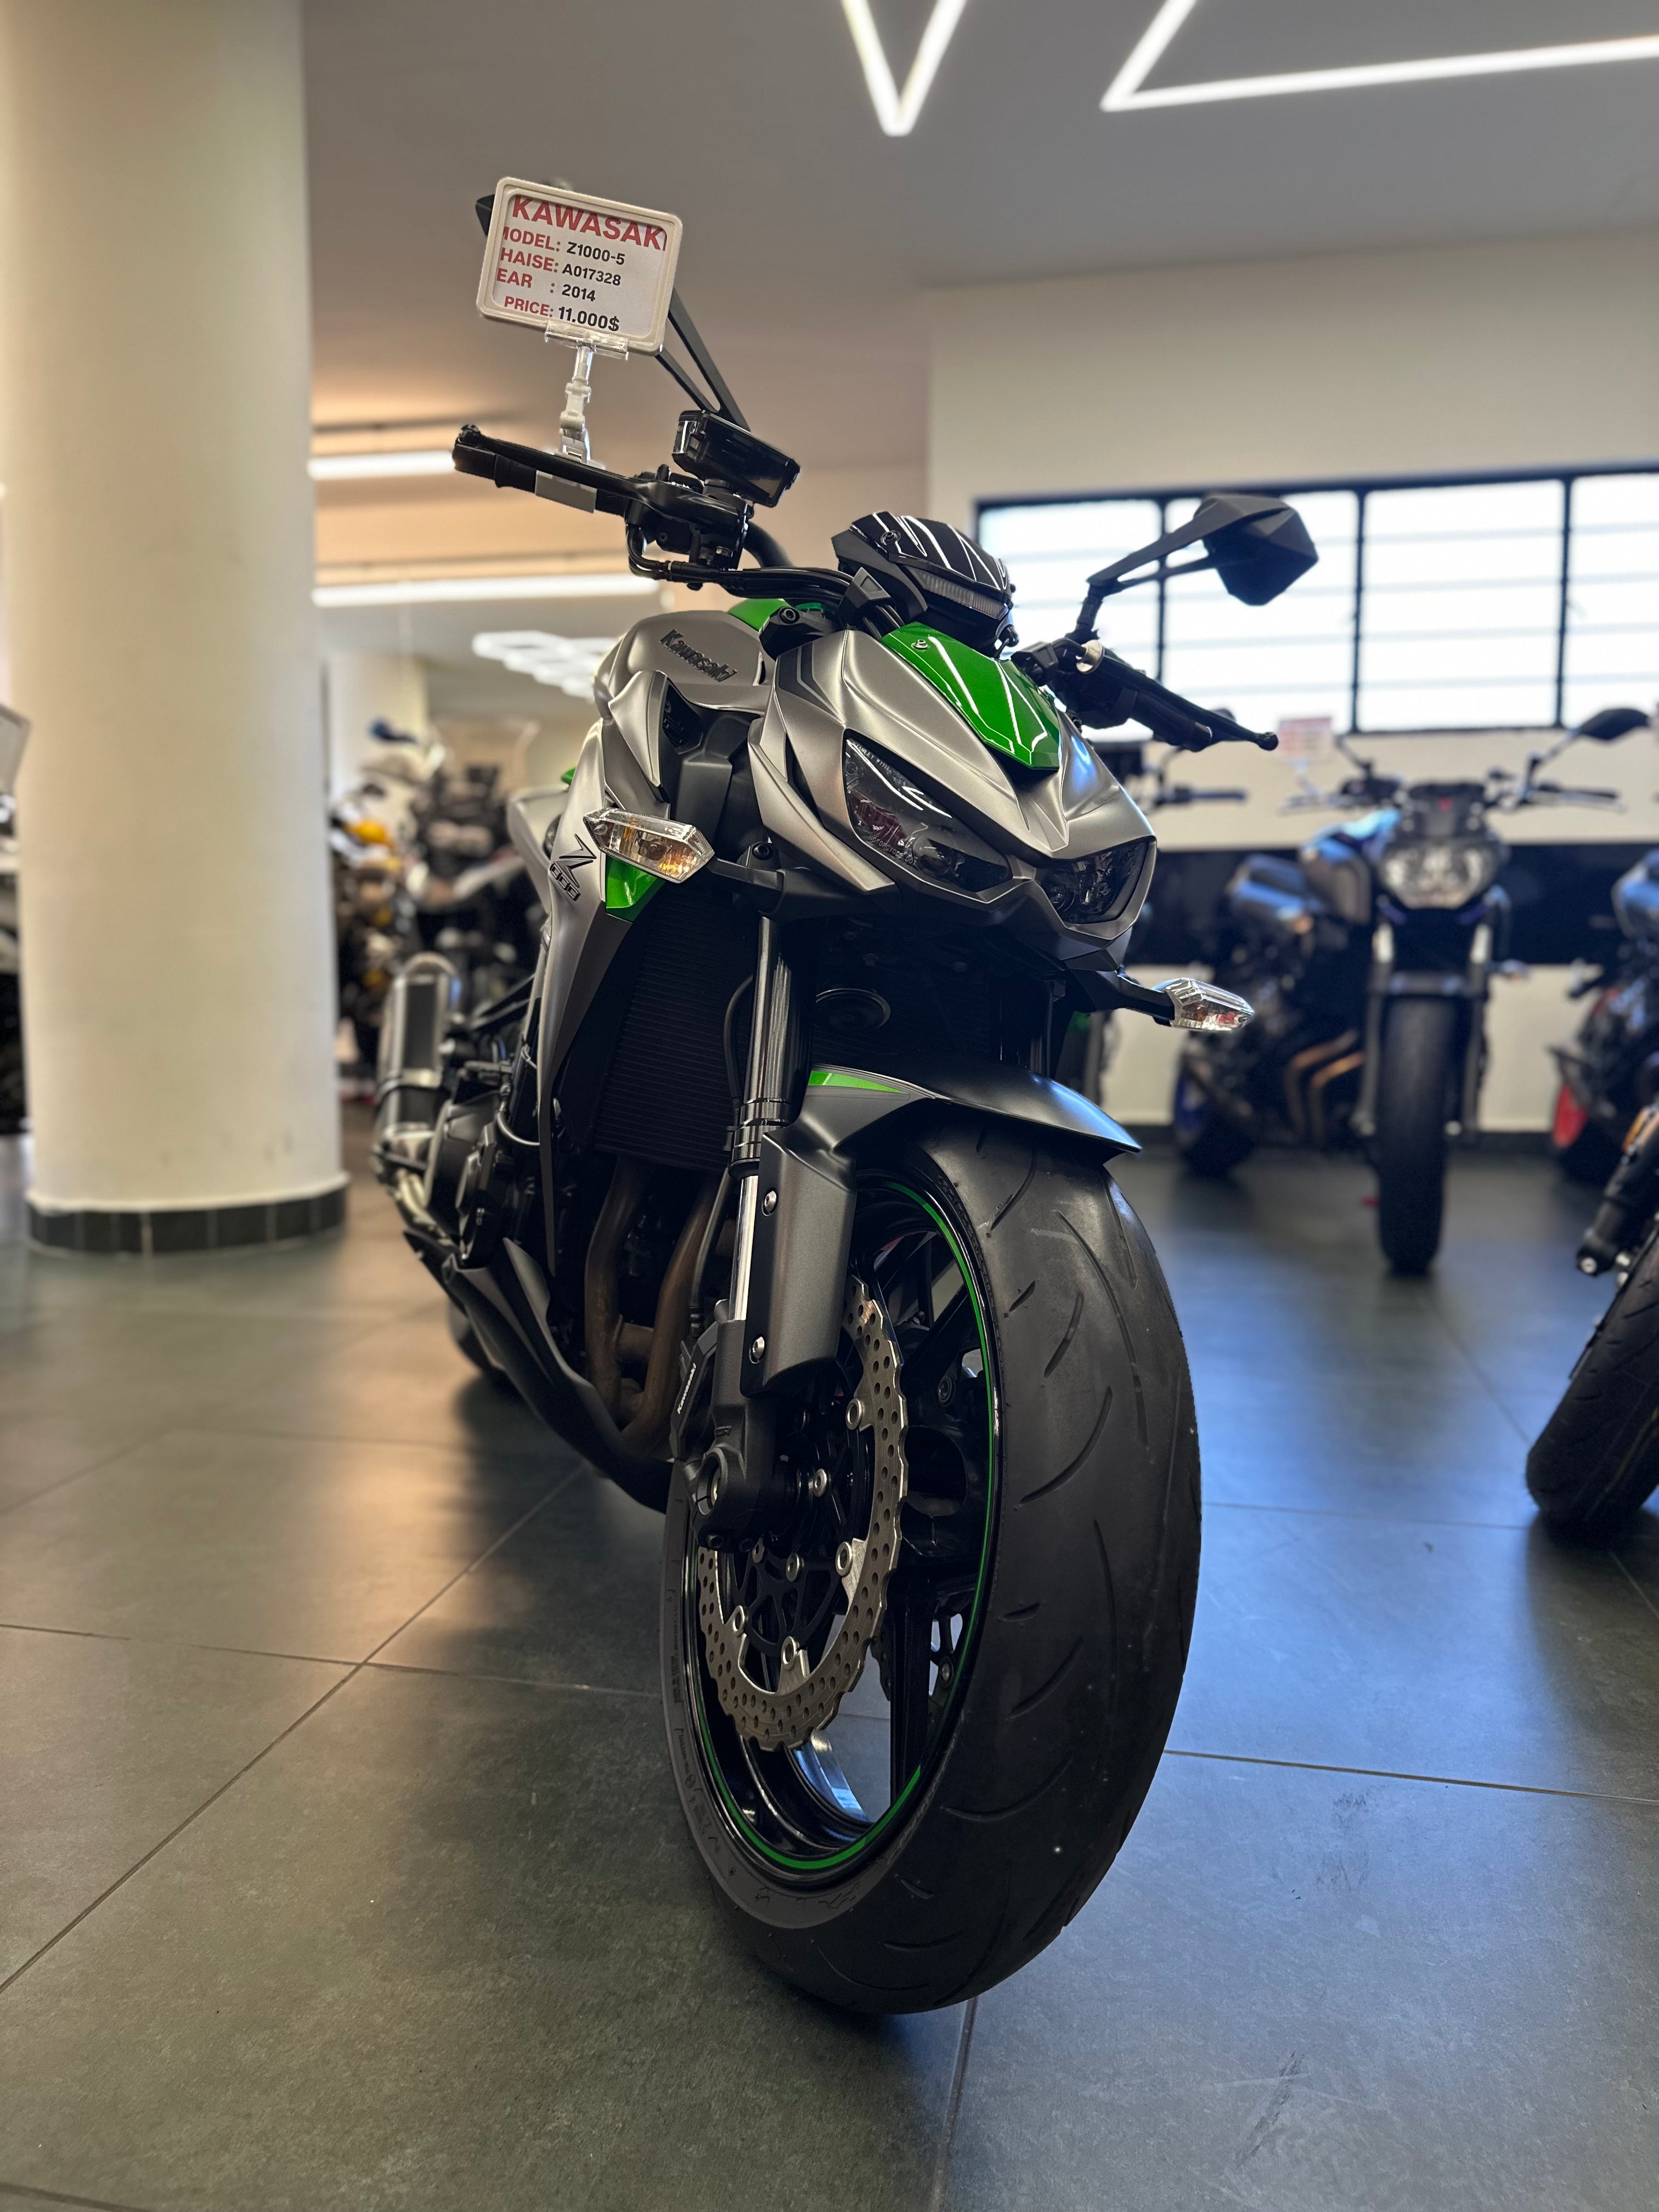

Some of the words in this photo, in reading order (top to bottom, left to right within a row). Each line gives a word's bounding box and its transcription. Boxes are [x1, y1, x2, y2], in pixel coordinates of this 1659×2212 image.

[566, 241, 626, 266] Z1000-5
[496, 267, 533, 289] EAR
[561, 284, 596, 302] 2014
[562, 263, 622, 286] A017328
[504, 296, 554, 318] PRICE:
[558, 306, 620, 332] 11.000$
[658, 628, 738, 682] Kawasaki
